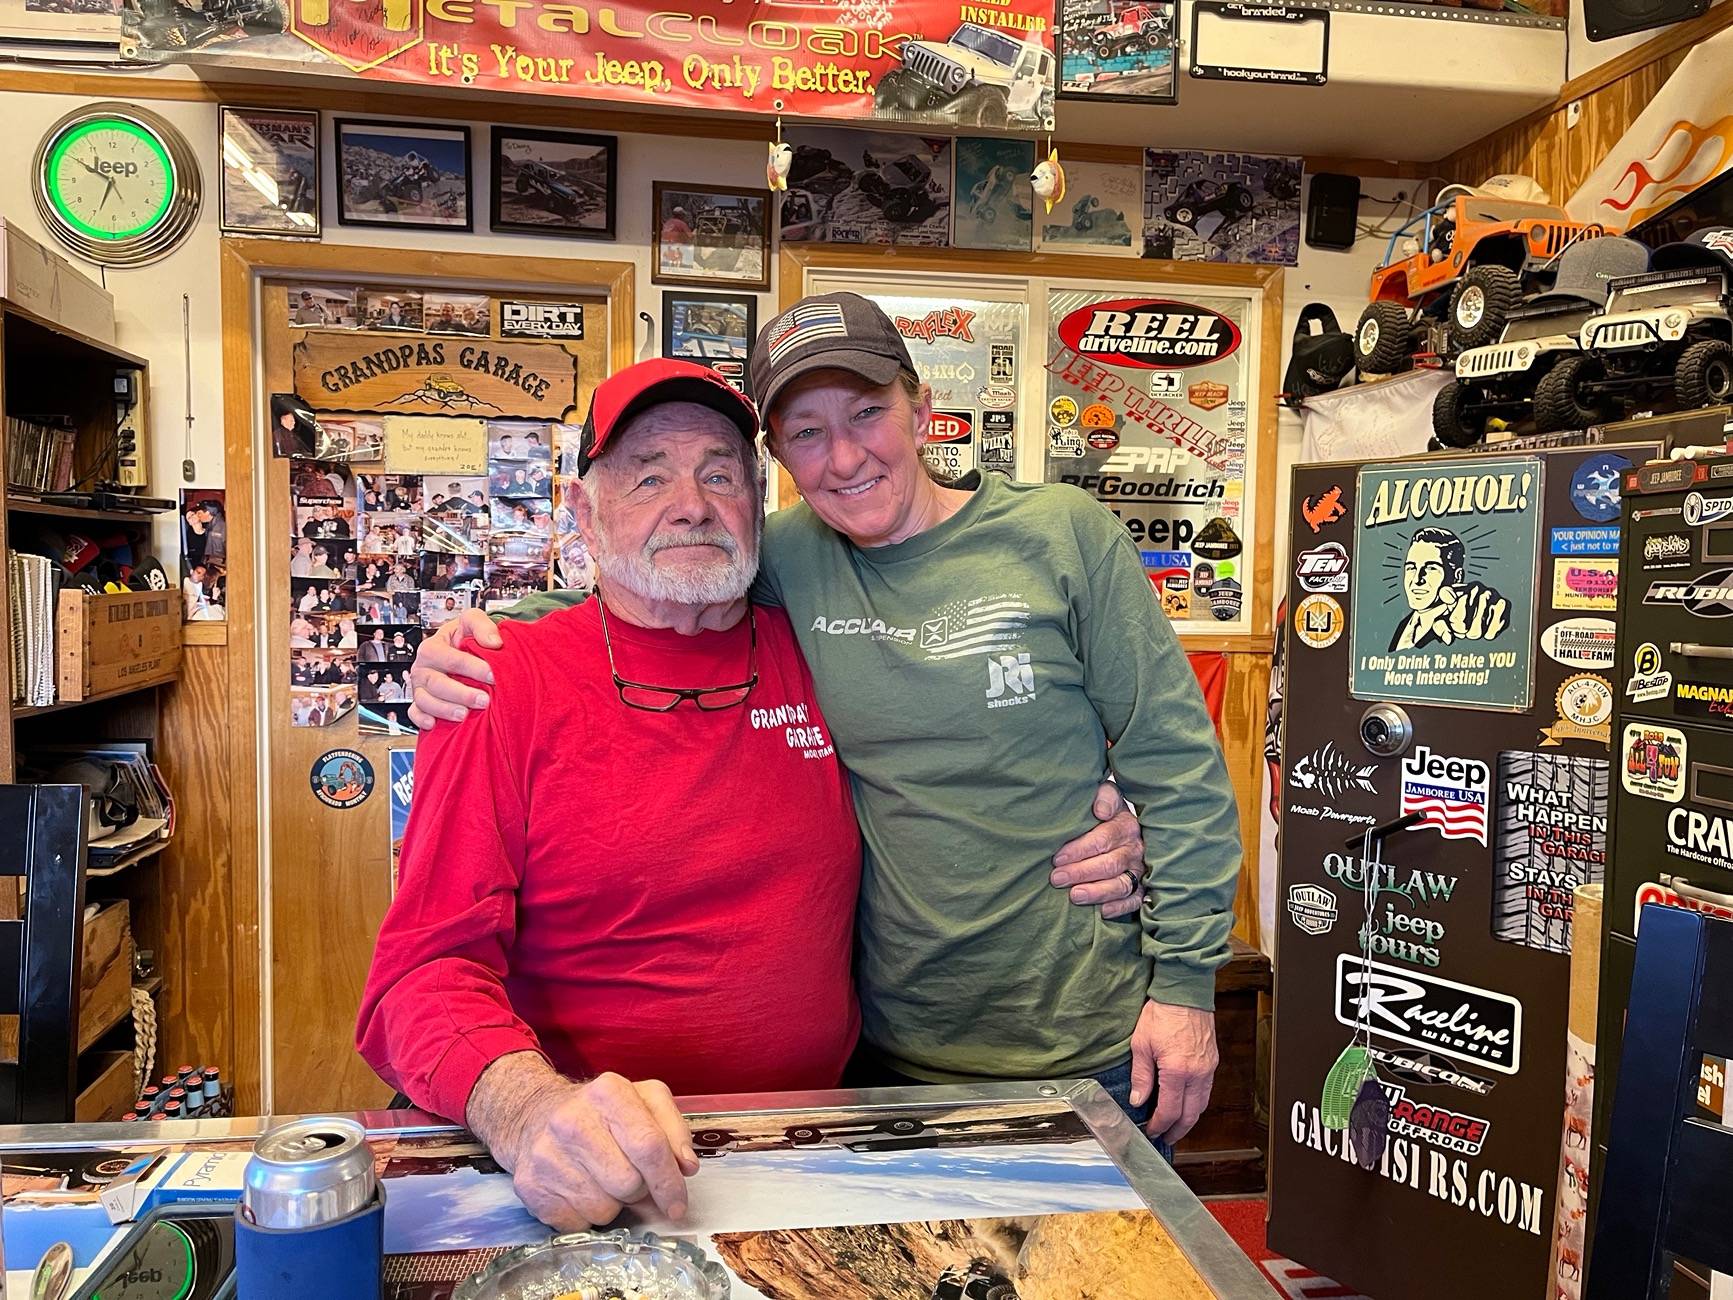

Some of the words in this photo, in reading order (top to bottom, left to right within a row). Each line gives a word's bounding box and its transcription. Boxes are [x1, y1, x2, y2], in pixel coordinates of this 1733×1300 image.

[960, 5, 1046, 32] INSTALLER
[1242, 7, 1286, 17] branded
[427, 42, 479, 77] It's
[491, 44, 574, 82] Your
[585, 52, 671, 95] Jeep,
[683, 53, 761, 98] Only
[772, 57, 876, 96] Better.
[86, 156, 138, 178] Jeep
[504, 303, 581, 323] DIRT
[504, 320, 550, 330] EVERY
[552, 322, 581, 332] DAY
[1085, 310, 1220, 341] REEL
[1078, 335, 1219, 356] driveline.com
[321, 343, 445, 393] GRANDPAS
[459, 346, 551, 402] GARAGE
[929, 420, 960, 436] RED
[1228, 420, 1245, 428] Jeep
[1365, 473, 1532, 528] ALCOHOL!
[1704, 500, 1733, 511] SPID
[1112, 510, 1193, 550] eep
[1553, 531, 1574, 540] YOUR
[1575, 530, 1608, 540] OPINION
[1609, 530, 1620, 539] MA
[1570, 541, 1585, 552] just
[1587, 542, 1600, 550] not
[1603, 542, 1612, 550] to
[1162, 553, 1189, 567] USA
[1300, 554, 1345, 573] TEN
[871, 635, 914, 645] SPENSION
[1560, 631, 1594, 639] OFF-ROAD
[1361, 656, 1367, 670] I
[1368, 656, 1393, 672] Only
[1397, 655, 1430, 670] Drink
[1434, 654, 1447, 669] To
[1450, 653, 1484, 669] Make
[1489, 652, 1516, 668] YOU
[1559, 648, 1582, 660] HALL
[1592, 650, 1613, 661] FAM
[1384, 671, 1413, 686] More
[1416, 670, 1489, 686] Interesting!
[1567, 681, 1608, 699] ALL-4-FUN
[987, 695, 1029, 709] shocks
[1708, 700, 1733, 714] Exh
[751, 703, 809, 730] GRANDPA'
[1406, 750, 1486, 788] Jeep
[1405, 782, 1456, 800] JAMBOREE
[1459, 789, 1483, 804] USA
[1506, 782, 1572, 807] WHAT
[1290, 804, 1319, 816] Moab
[1320, 806, 1377, 825] Powersports
[1517, 804, 1607, 833] HAPPEN
[1528, 823, 1546, 840] IN
[1550, 826, 1592, 845] THIS
[1667, 844, 1679, 855] The
[1681, 848, 1712, 864] Hardcore
[1713, 857, 1733, 870] Offroa
[1323, 853, 1458, 903] OUTLAW
[1509, 862, 1578, 890] STAYS
[1296, 891, 1331, 907] OUTLAW
[1526, 885, 1545, 901] IN
[1549, 888, 1573, 906] TH
[1539, 903, 1573, 921] GAR
[1382, 903, 1445, 945] jeep
[1358, 919, 1441, 968] tours
[1345, 972, 1510, 1046] Raceline
[1421, 1029, 1503, 1058] wheels
[1393, 1101, 1485, 1141] RANGE
[1389, 1120, 1480, 1154] OFF-ROAD
